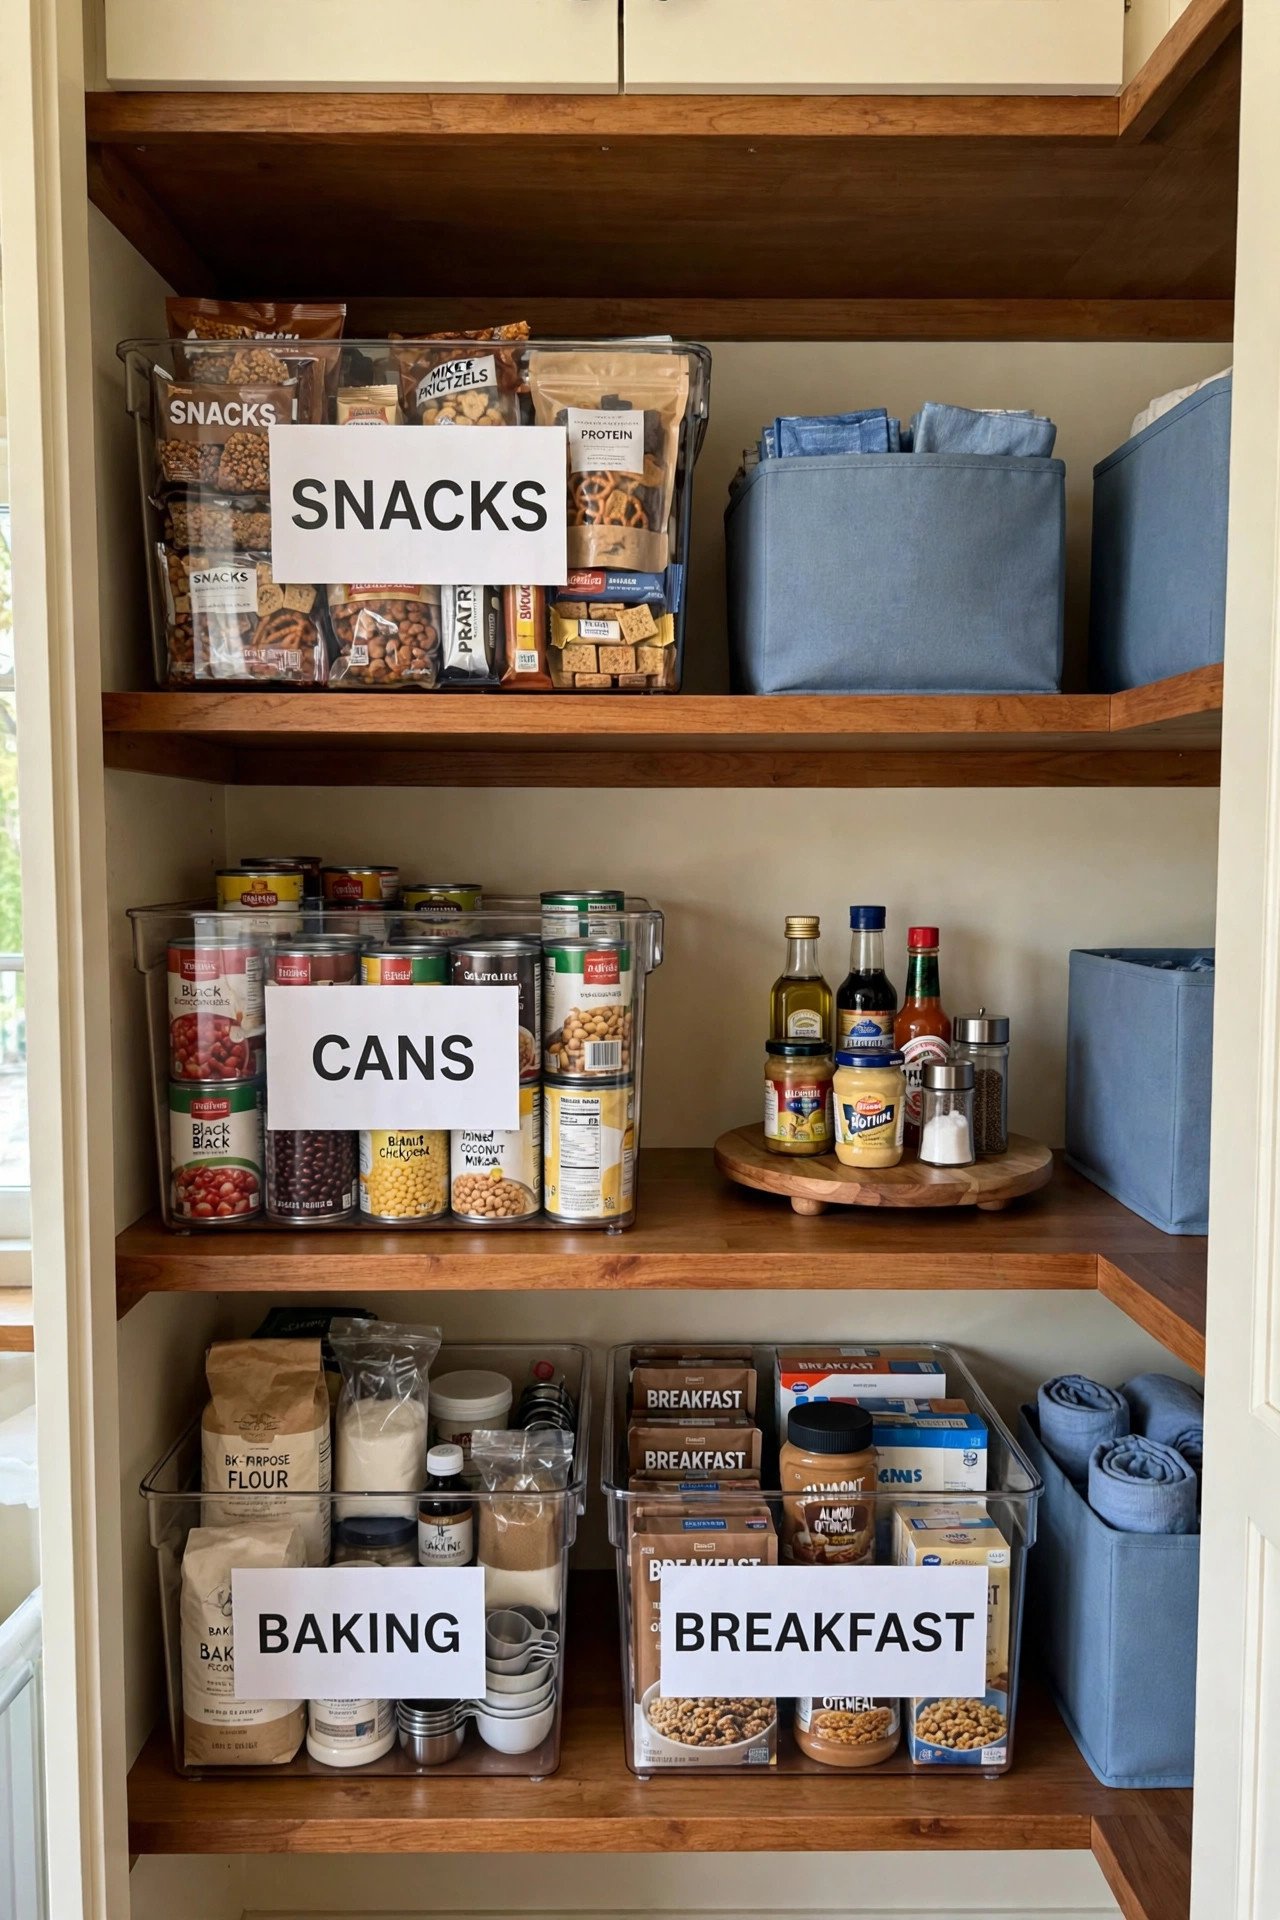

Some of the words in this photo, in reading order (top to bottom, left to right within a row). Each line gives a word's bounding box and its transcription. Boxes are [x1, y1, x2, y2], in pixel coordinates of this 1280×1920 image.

[169, 400, 277, 427] SNACKS
[581, 429, 633, 441] PROTEIN
[291, 478, 548, 532] SNACKS
[193, 572, 249, 584] SNACKS
[312, 1034, 475, 1081] CANS
[460, 1143, 505, 1155] COCONUT
[798, 1362, 875, 1371] BREAKFAST
[646, 1389, 743, 1409] BREAKFAST
[645, 1450, 746, 1469] BREAKFAST
[228, 1470, 289, 1489] FLOUR
[258, 1612, 460, 1654] BAKING
[675, 1611, 975, 1652] BREAKFAST
